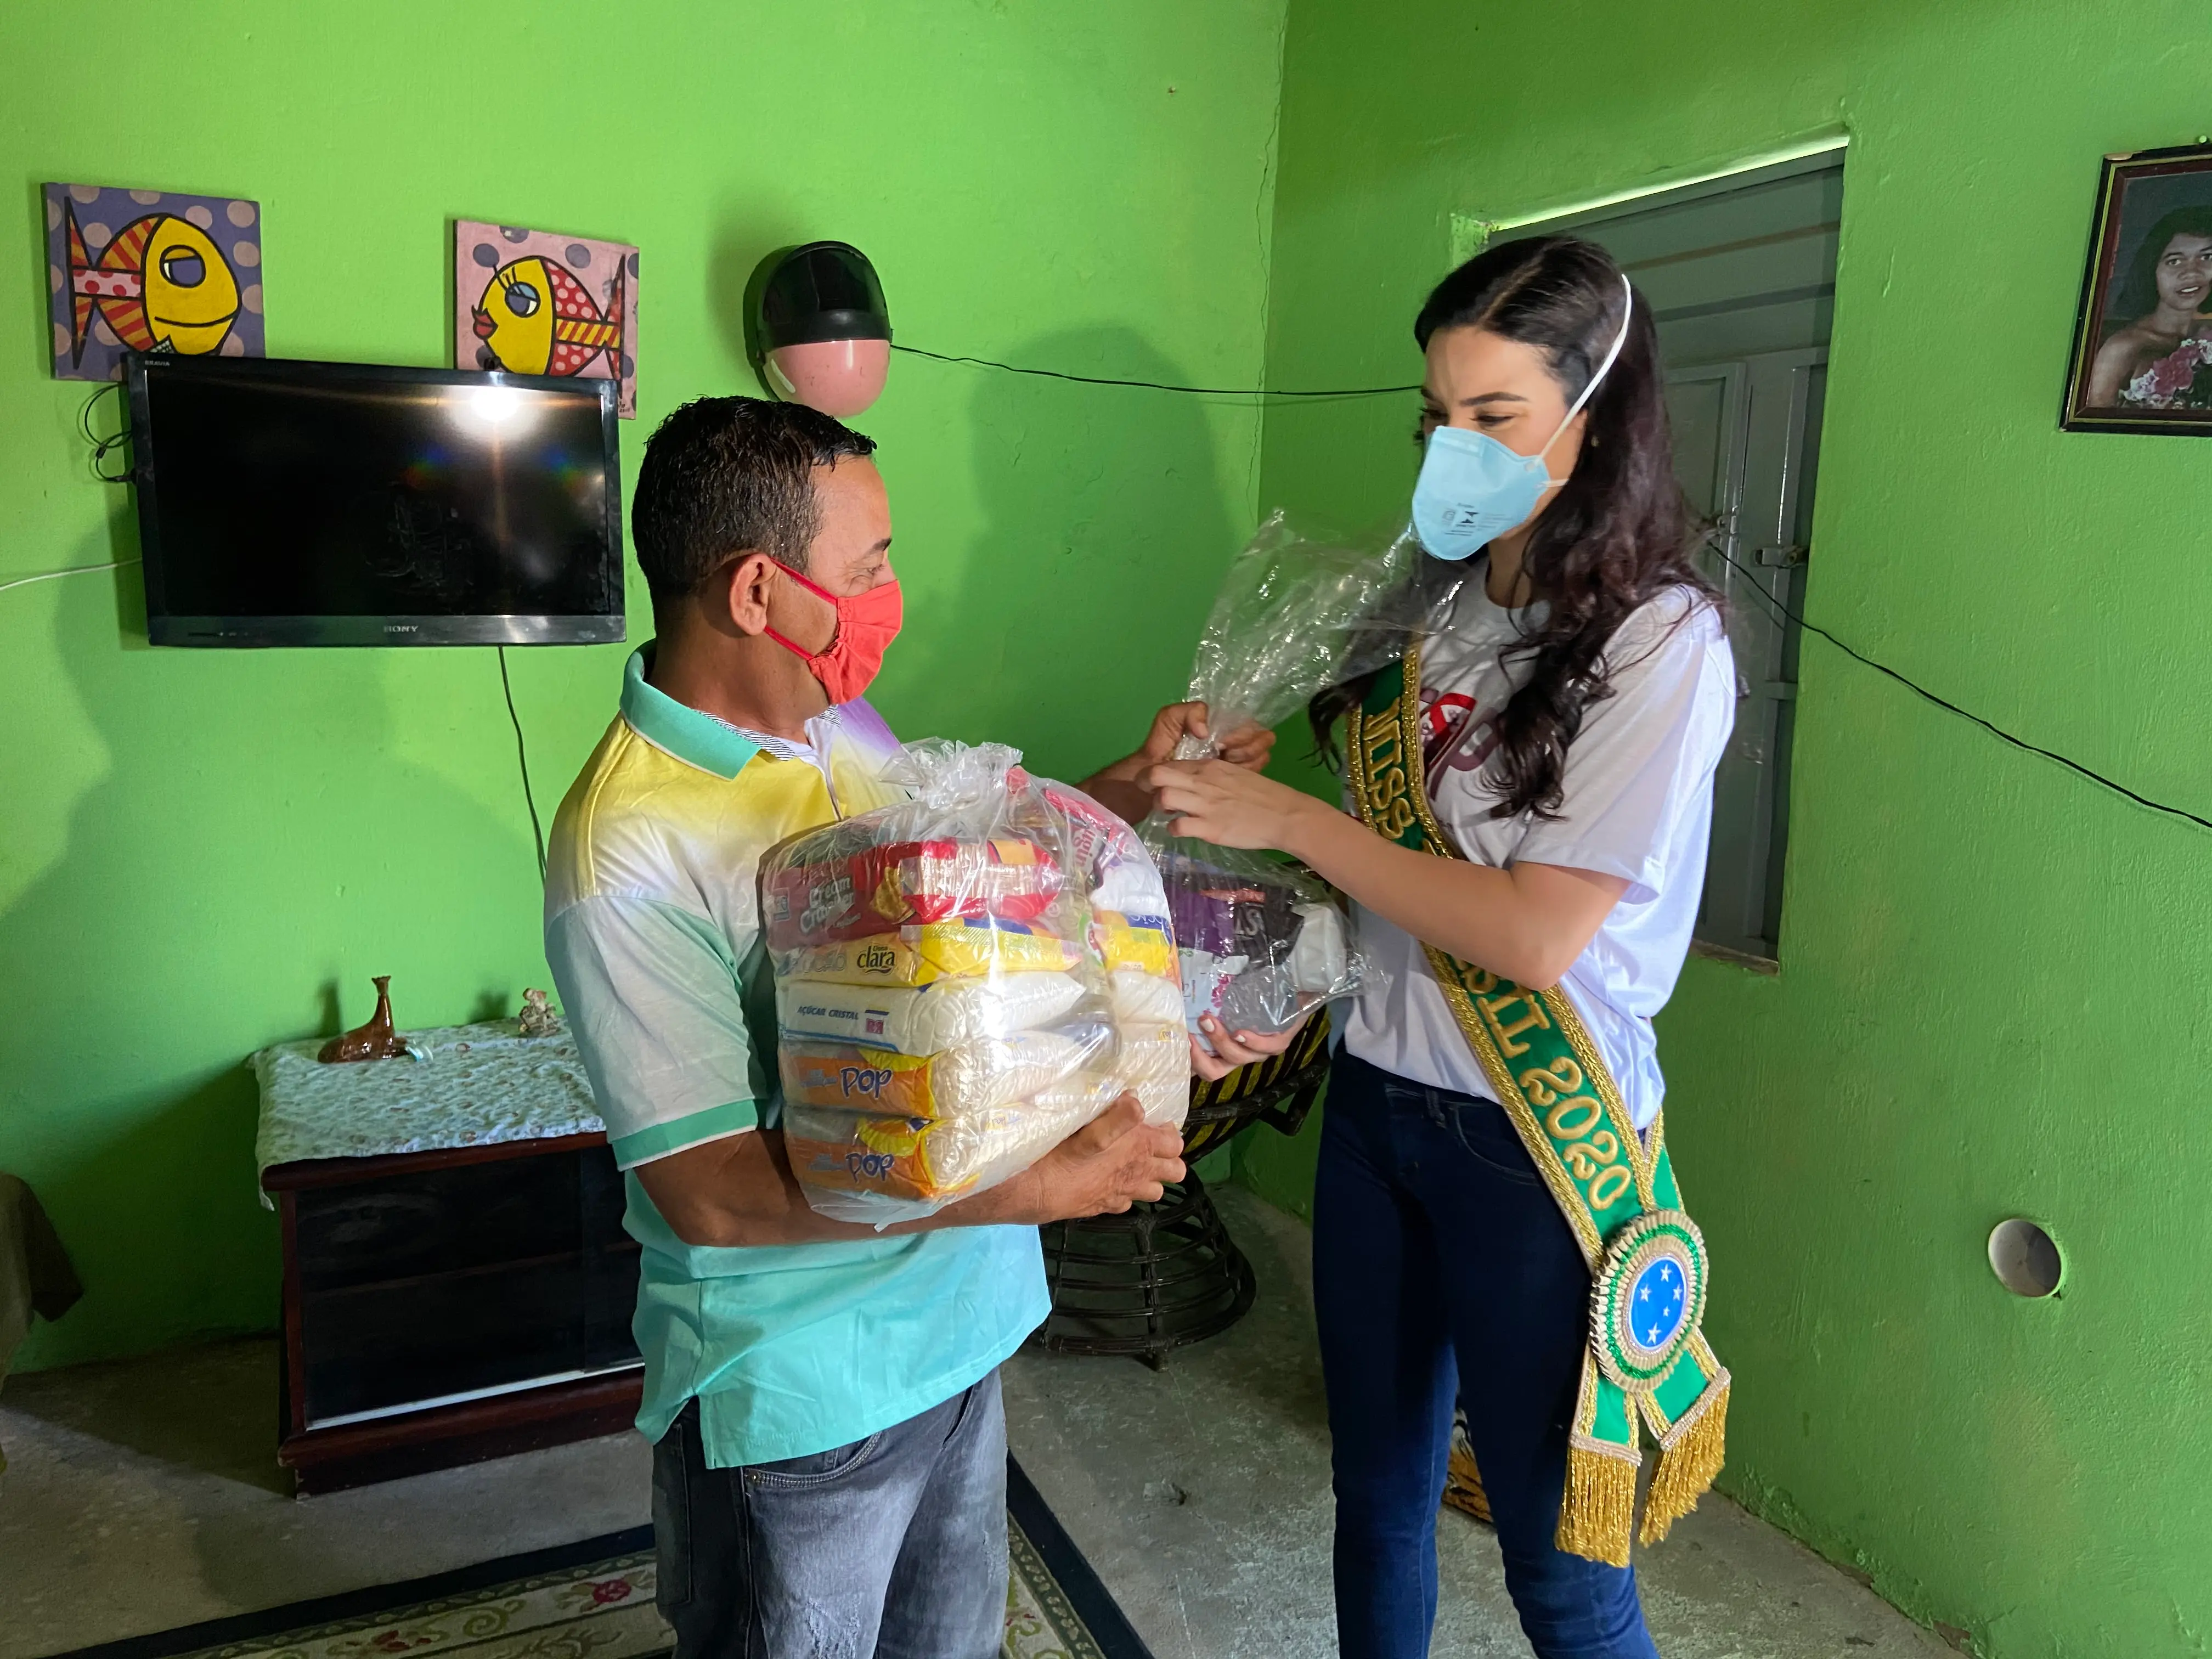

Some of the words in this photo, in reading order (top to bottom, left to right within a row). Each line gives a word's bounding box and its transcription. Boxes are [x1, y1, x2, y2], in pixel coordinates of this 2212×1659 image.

[856, 945, 896, 969] clara
[1363, 696, 1417, 840] MISS
[1519, 1056, 1632, 1211] 2020
[797, 1005, 826, 1016] AÇÚCAR
[828, 1009, 859, 1020] CRISTAL
